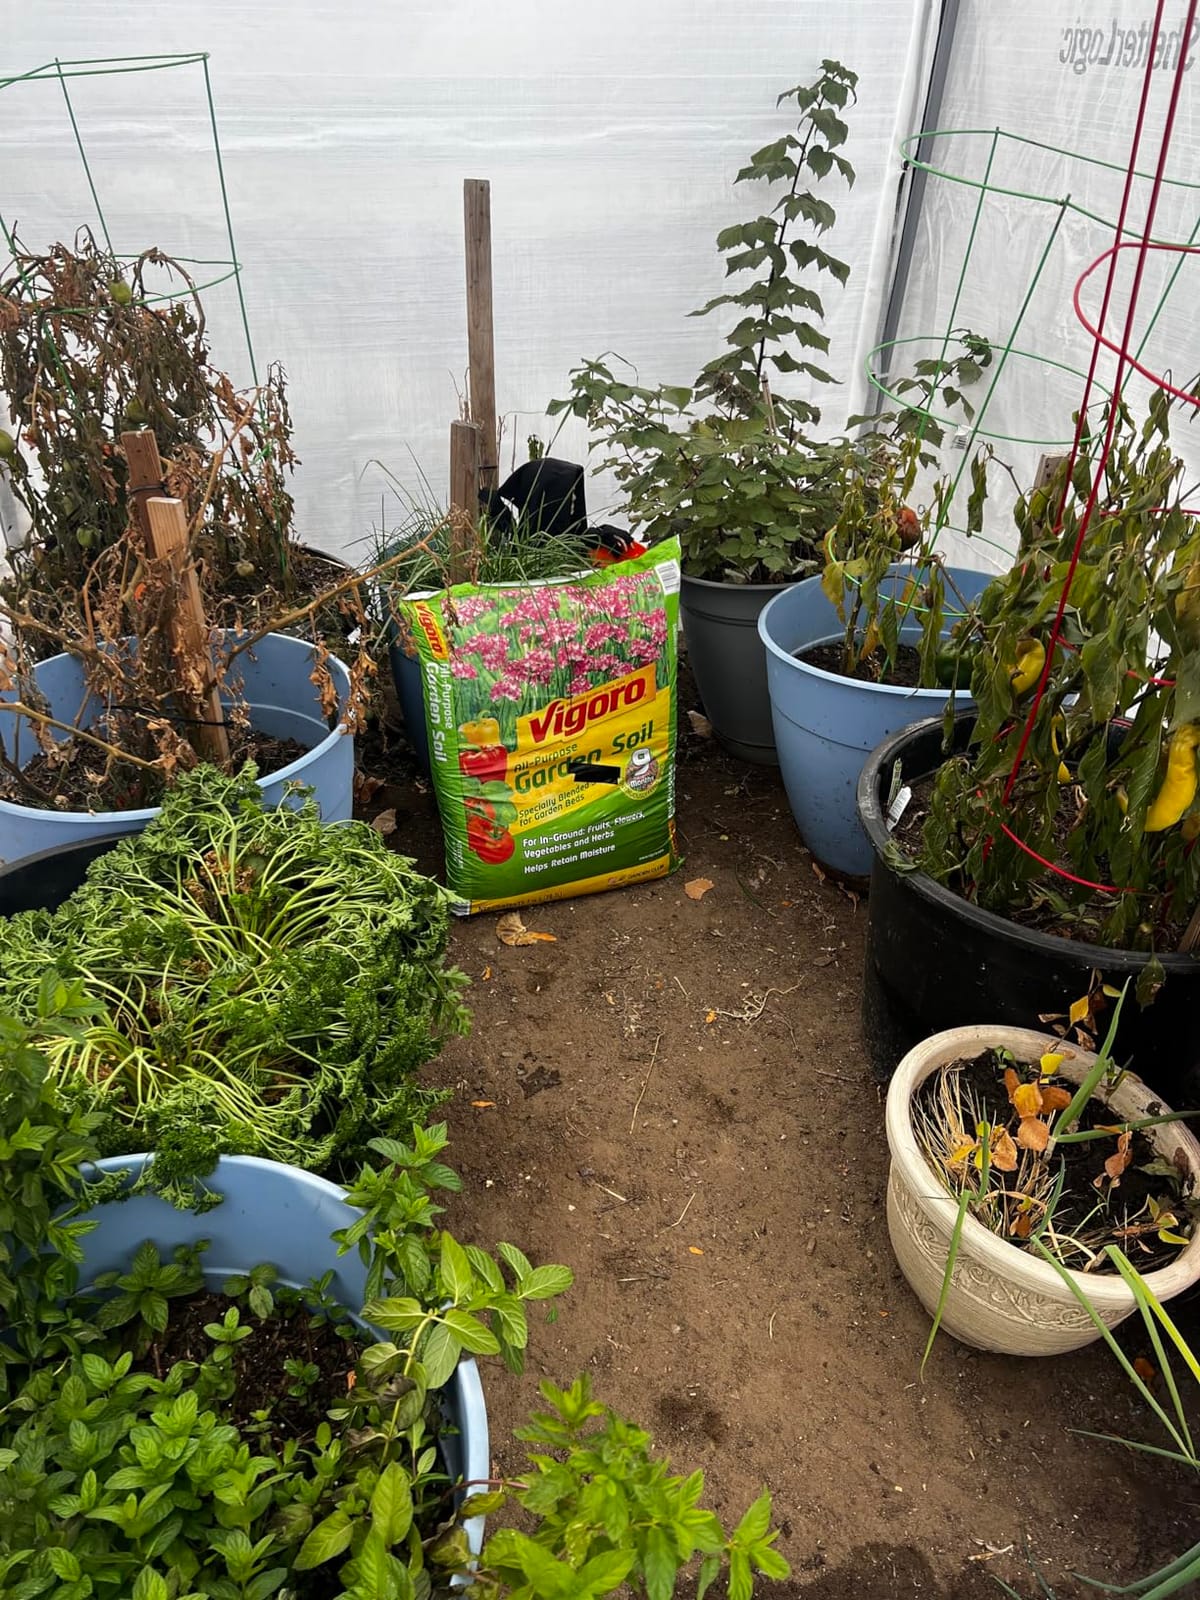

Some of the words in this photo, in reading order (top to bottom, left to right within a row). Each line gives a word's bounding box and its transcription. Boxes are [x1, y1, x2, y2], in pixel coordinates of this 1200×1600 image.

[415, 603, 443, 655] Vigoro
[425, 661, 441, 725] Garden
[440, 662, 453, 729] All-Purpose
[528, 677, 646, 744] Vigoro
[432, 730, 447, 763] Soil
[611, 719, 653, 755] Soil
[514, 743, 578, 773] All-Purpose
[632, 747, 652, 776] 9
[519, 795, 556, 818] Specially
[558, 782, 590, 801] Blended
[519, 816, 532, 827] for
[534, 802, 563, 820] Garden
[565, 793, 585, 808] Beds
[523, 837, 537, 847] For
[540, 828, 586, 844] In-Ground:
[524, 842, 572, 859] Vegetables
[574, 837, 590, 847] and
[591, 830, 615, 842] Herbs
[524, 861, 549, 875] Helps
[551, 854, 578, 867] Retain
[580, 844, 616, 860] Moisture
